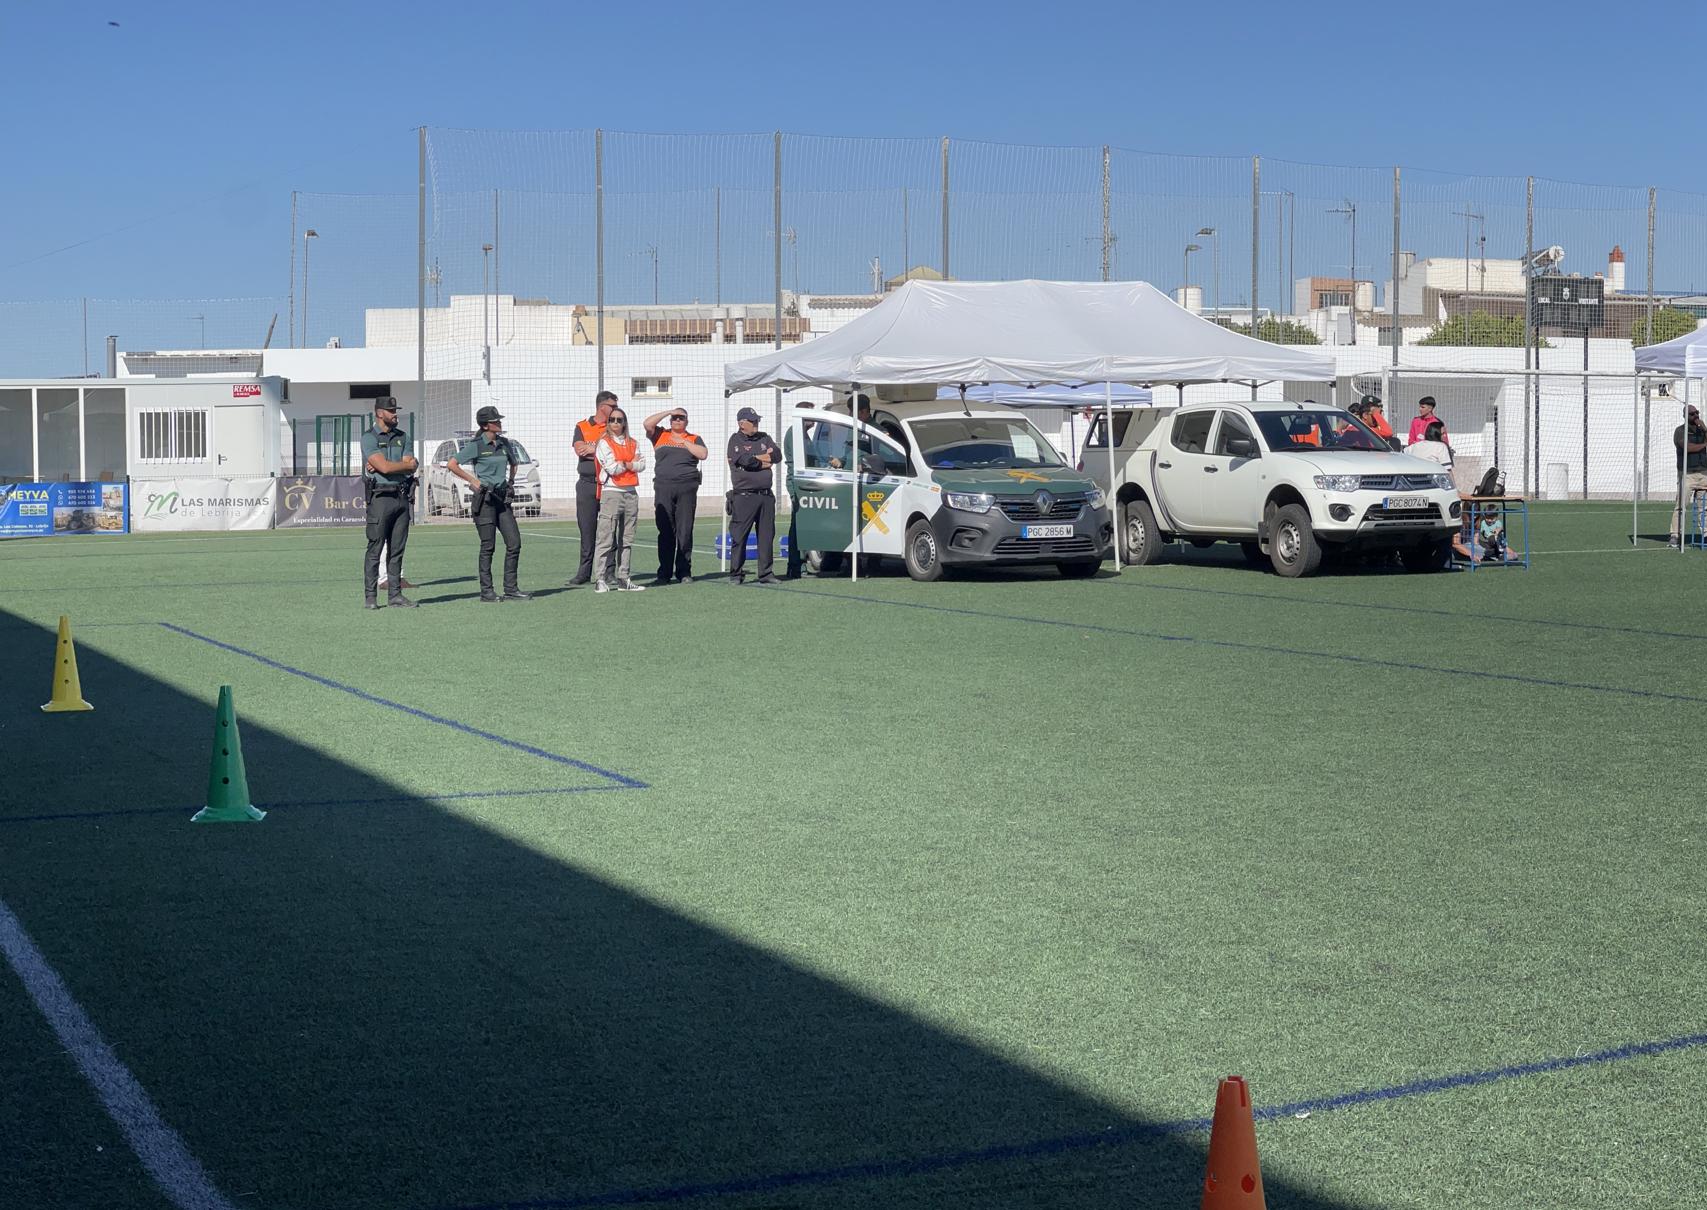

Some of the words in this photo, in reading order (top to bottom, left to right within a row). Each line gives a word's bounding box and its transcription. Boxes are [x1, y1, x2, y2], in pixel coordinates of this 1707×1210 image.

[234, 385, 260, 393] REMSA
[181, 498, 204, 507] LAS
[207, 497, 270, 507] MARISMAS
[284, 493, 316, 510] CV
[324, 496, 348, 509] Bar
[799, 496, 839, 509] CIVIL
[1028, 527, 1043, 537] PGC
[1044, 527, 1065, 536] 2856
